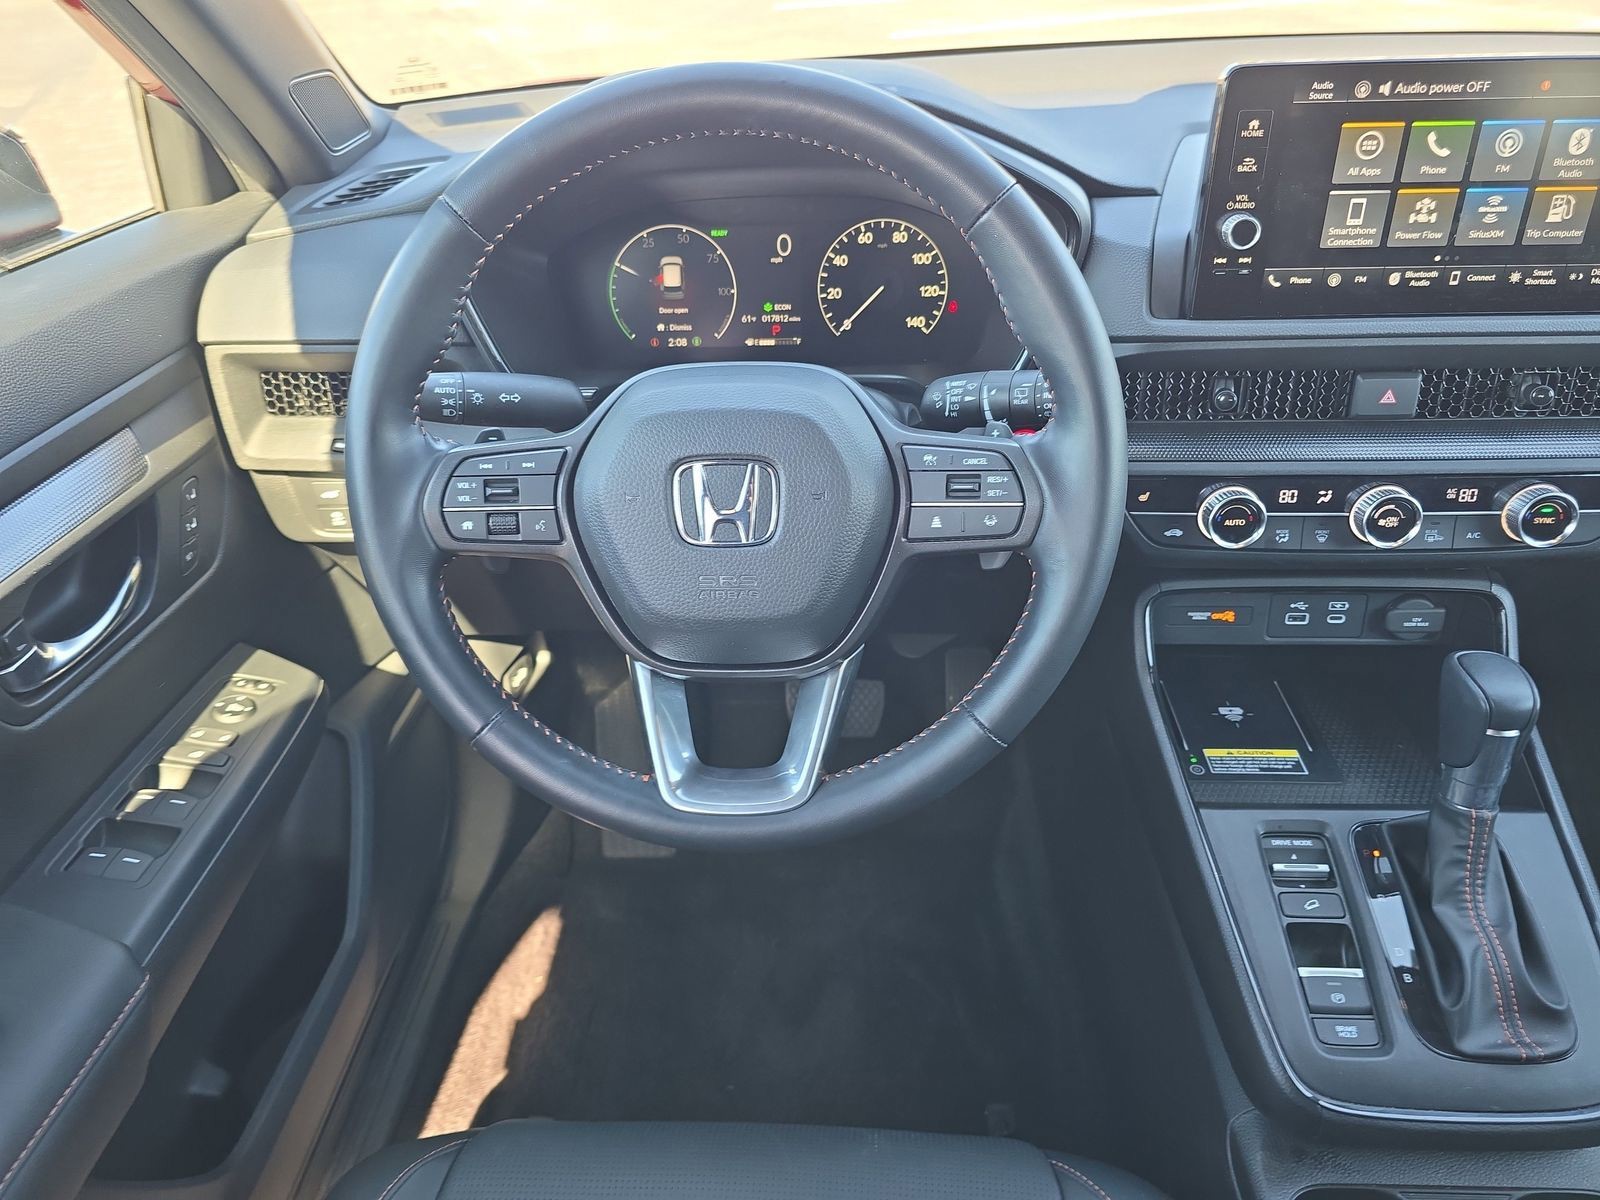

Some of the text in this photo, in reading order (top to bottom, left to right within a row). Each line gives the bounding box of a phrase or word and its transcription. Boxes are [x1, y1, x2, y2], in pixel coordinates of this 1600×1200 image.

[1312, 81, 1334, 90] Audio
[1395, 81, 1492, 95] Audio power OFF
[1308, 92, 1334, 100] Source
[1553, 158, 1594, 167] Bluetooth
[1347, 167, 1381, 176] All Apps
[1420, 166, 1447, 174] Phone
[1495, 164, 1510, 173] FM
[1558, 169, 1582, 178] Audio
[1328, 227, 1376, 236] Smartphone
[1422, 230, 1443, 239] Flow
[1468, 229, 1504, 239] SiriusXM
[1527, 229, 1583, 239] Trip Computer
[677, 234, 689, 244] 50
[858, 232, 873, 244] 60
[892, 231, 908, 244] 80
[1327, 238, 1373, 246] Connection
[642, 238, 654, 248] 25
[776, 233, 792, 257] 0
[707, 254, 719, 263] 75
[832, 255, 848, 267] 40
[912, 253, 932, 264] 100
[1405, 270, 1438, 278] Bluetooth
[1290, 276, 1312, 284] Phone
[718, 287, 731, 296] 100
[827, 288, 842, 299] 20
[920, 285, 940, 297] 120
[761, 315, 789, 323] 017812
[906, 316, 926, 328] 140
[772, 324, 781, 336] P
[668, 338, 688, 347] 2:08
[1278, 489, 1298, 504] 80
[1458, 488, 1478, 502] 80
[699, 575, 758, 587] SRS
[699, 590, 759, 599] AIRBAG
[1403, 974, 1413, 983] B
